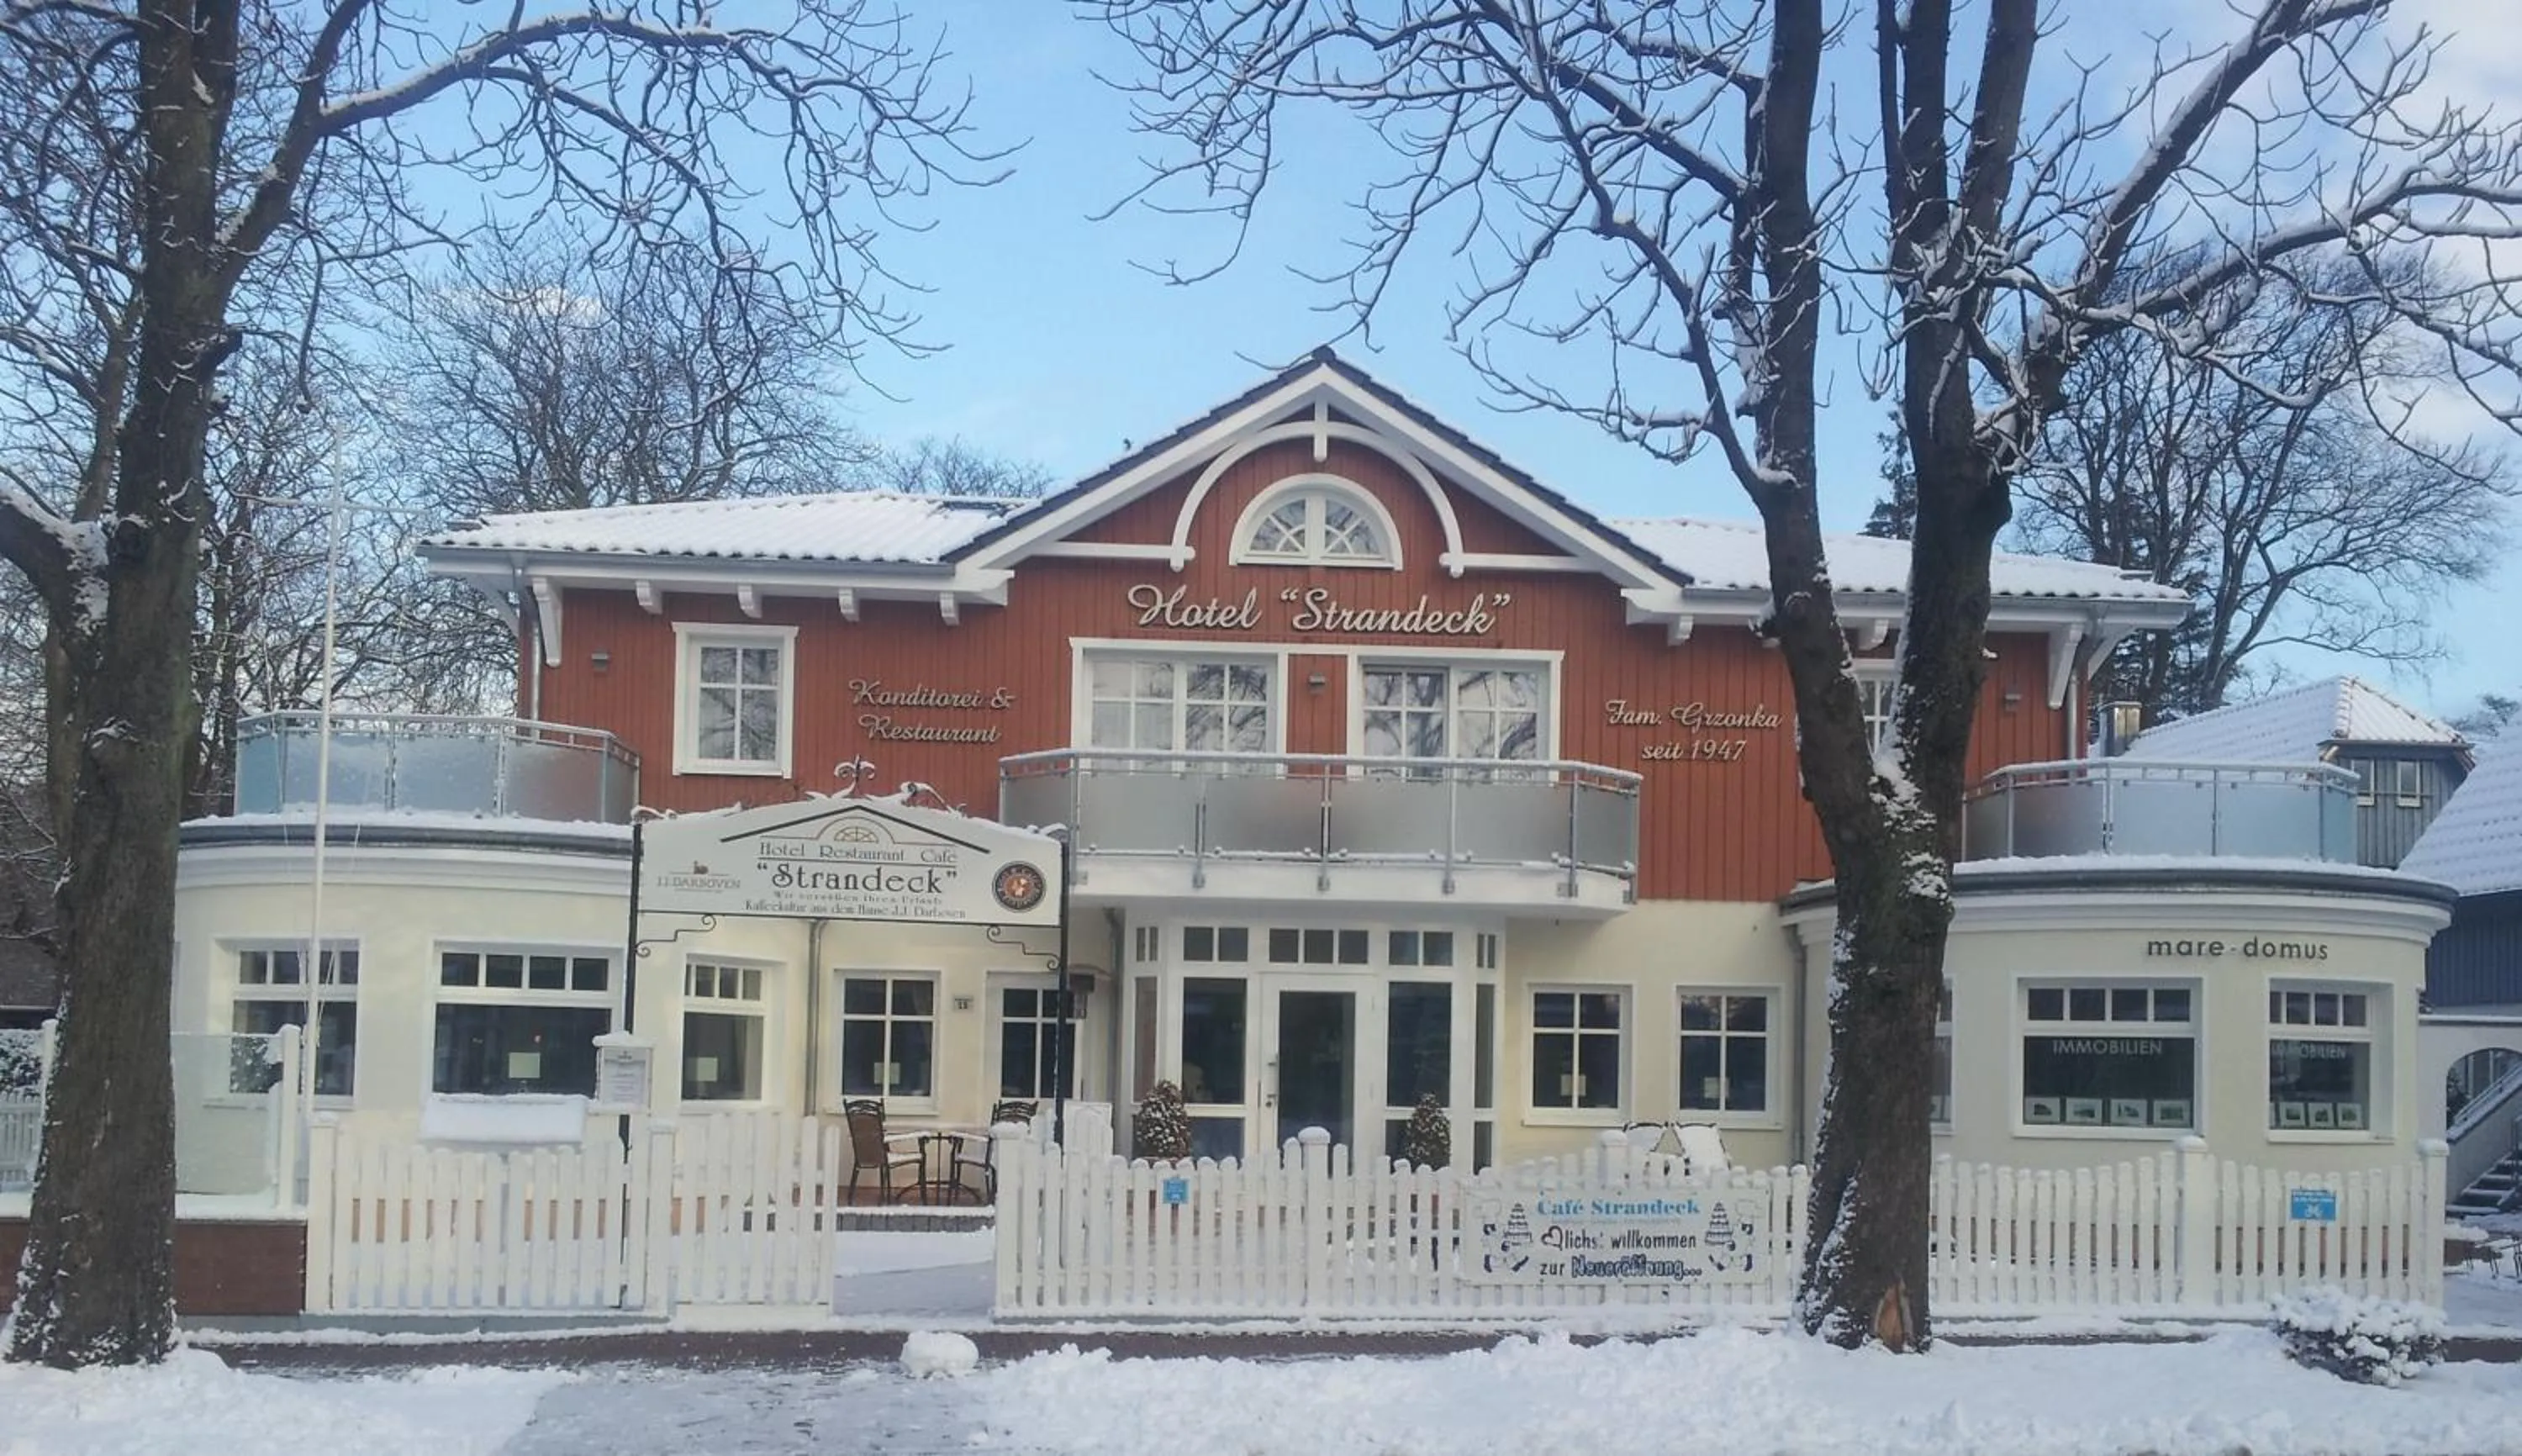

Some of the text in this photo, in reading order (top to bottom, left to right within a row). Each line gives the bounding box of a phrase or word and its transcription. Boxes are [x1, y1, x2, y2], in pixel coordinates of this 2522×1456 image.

[1127, 583, 1262, 629] Hotel
[849, 678, 1016, 709] Konditorei &
[1606, 699, 1783, 733] Fam. Grzonka
[858, 715, 1001, 742] Restaurant
[1642, 740, 1747, 760] seit 1947
[760, 842, 805, 857] Hotel
[819, 845, 905, 862] Restaurant
[2053, 1039, 2162, 1056] IMMOBILIEN
[1537, 1199, 1701, 1216] Café Strandeck
[1611, 1230, 1696, 1249] willkommen
[1539, 1263, 1565, 1276] zur
